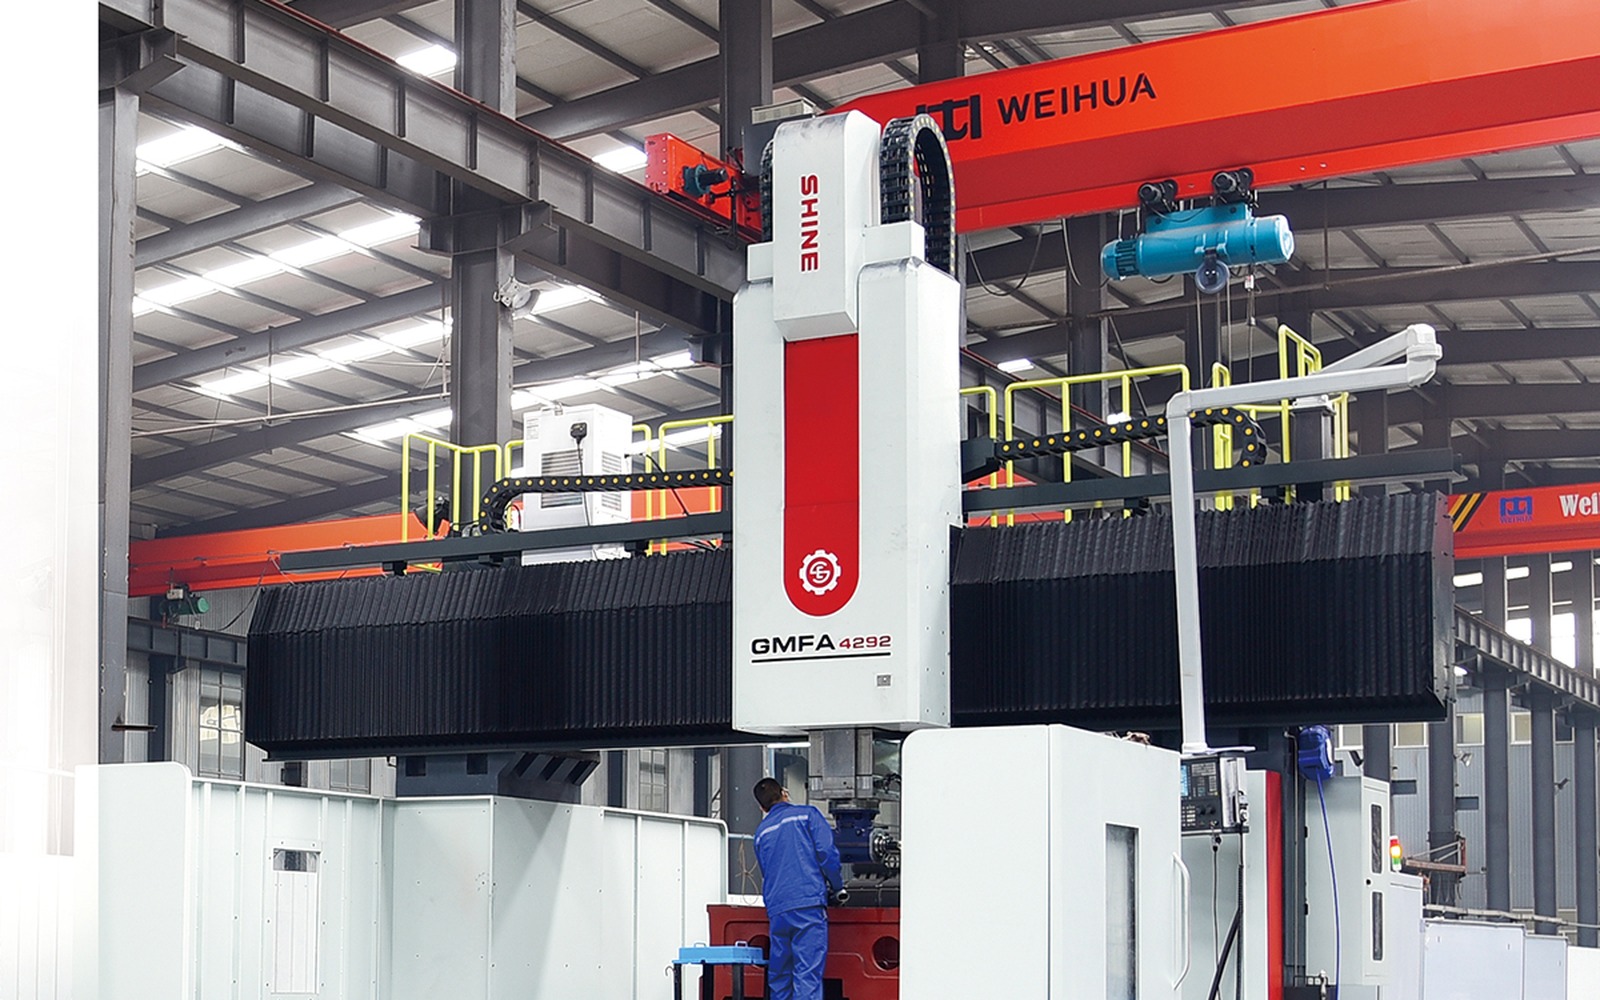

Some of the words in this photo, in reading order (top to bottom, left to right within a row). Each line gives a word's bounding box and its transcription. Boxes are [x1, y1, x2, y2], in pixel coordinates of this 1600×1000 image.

[997, 73, 1156, 125] WEIHUA
[801, 175, 818, 272] SHINE
[1559, 492, 1600, 518] Wei
[752, 634, 836, 654] GMFA
[839, 635, 891, 649] 4292
